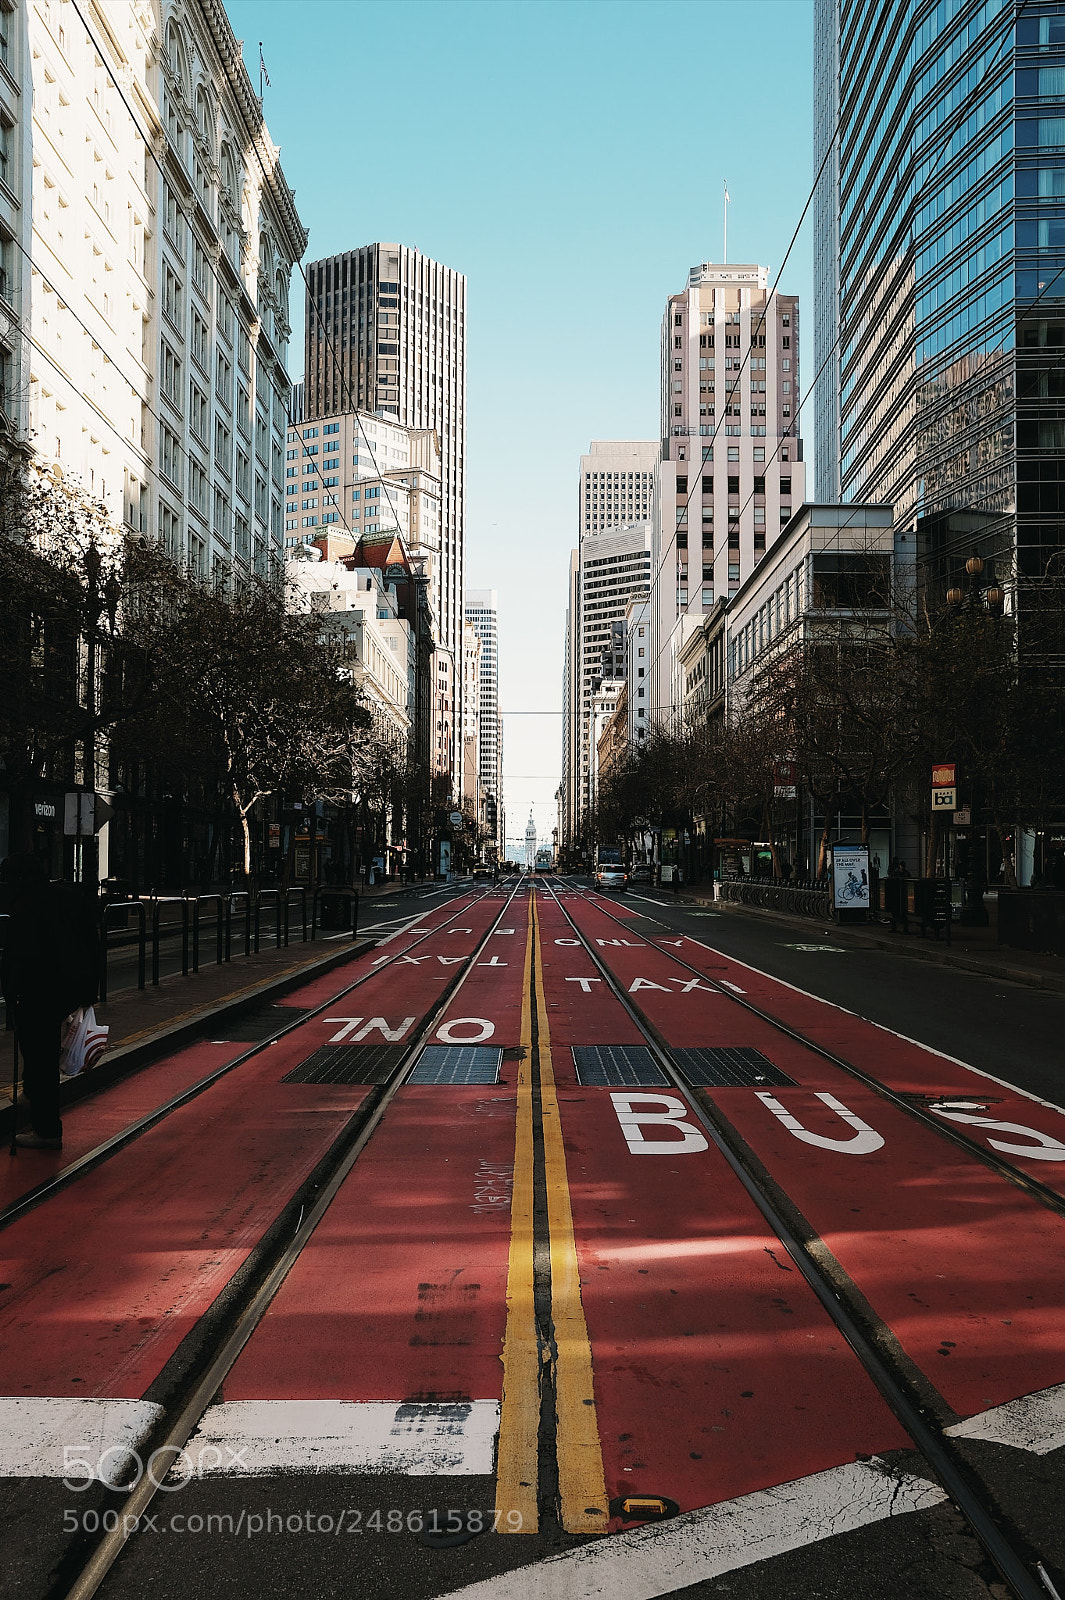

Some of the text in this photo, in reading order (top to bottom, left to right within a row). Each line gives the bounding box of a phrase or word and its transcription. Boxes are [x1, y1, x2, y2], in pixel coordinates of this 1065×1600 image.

[34, 801, 55, 817] verizon
[554, 938, 684, 947] ONLY
[371, 955, 508, 966] TAXI
[564, 977, 748, 994] TAXI
[609, 1092, 1065, 1162] BUS
